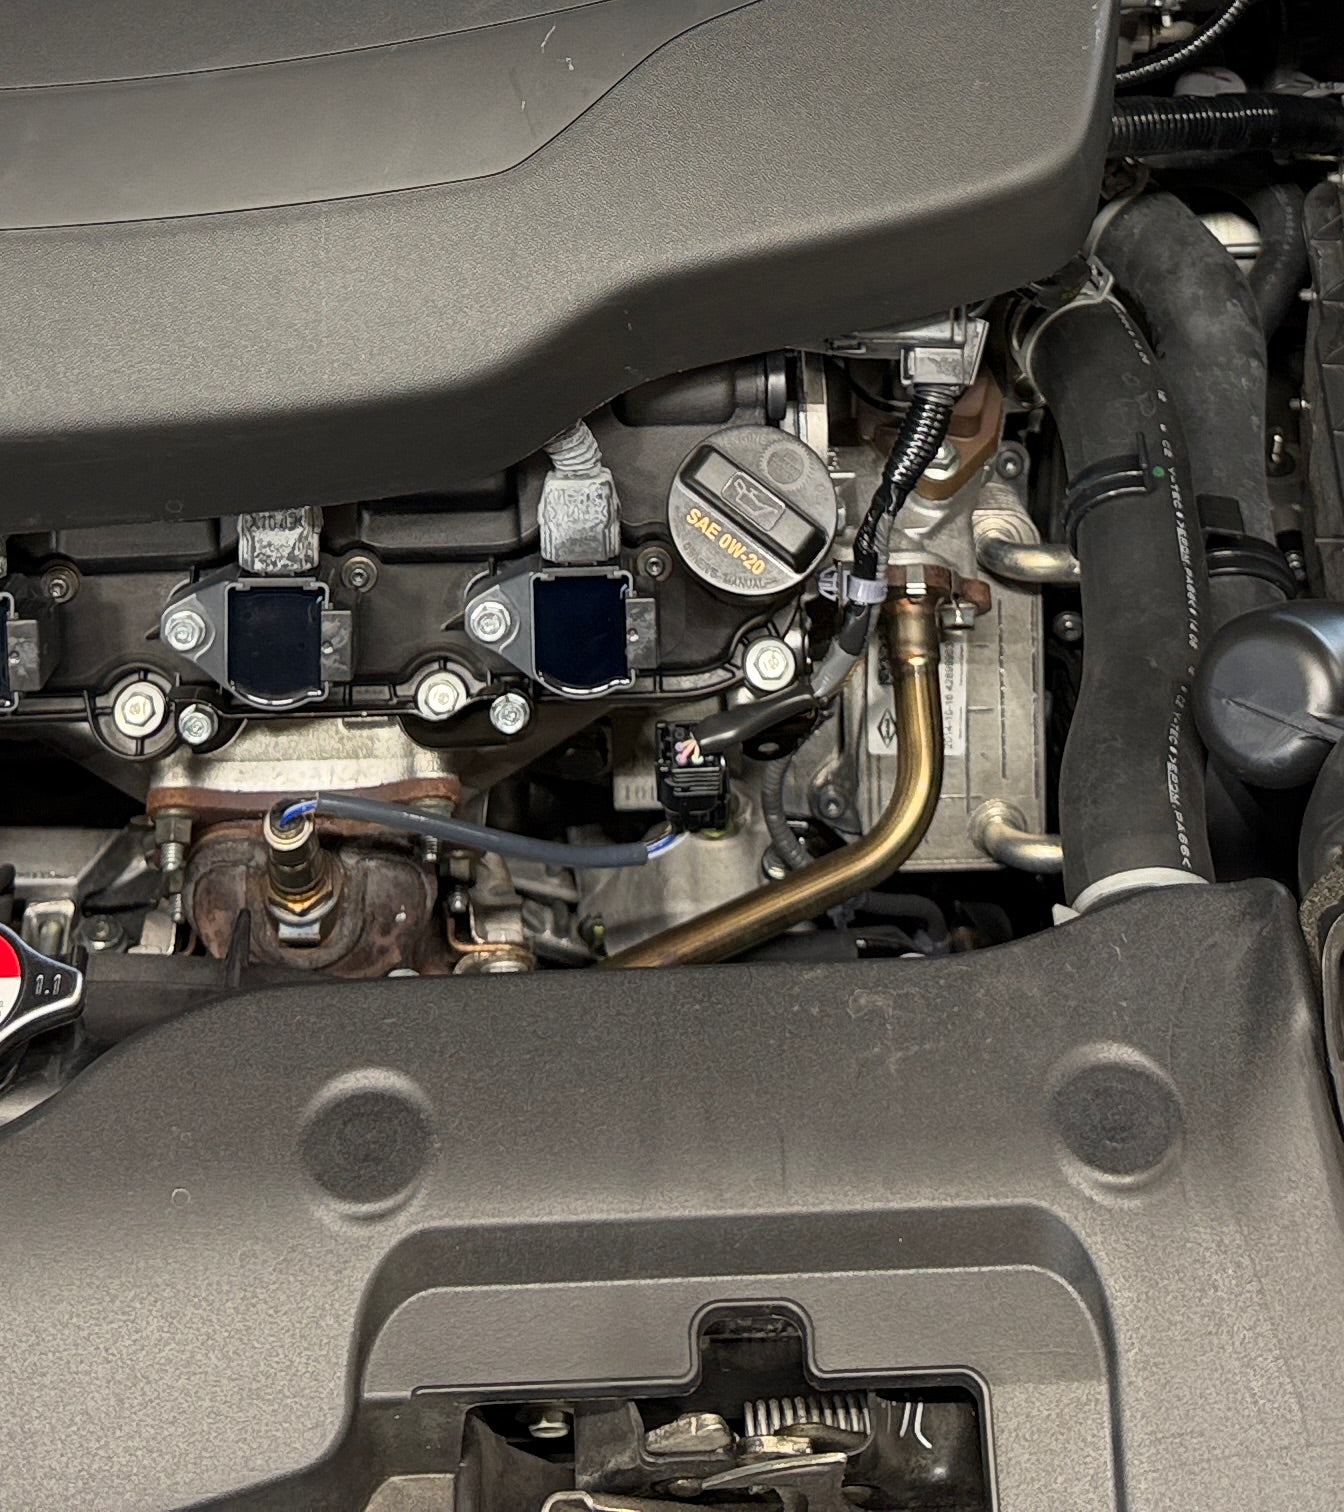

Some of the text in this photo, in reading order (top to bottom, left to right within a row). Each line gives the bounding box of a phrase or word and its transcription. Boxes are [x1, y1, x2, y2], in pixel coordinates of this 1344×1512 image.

[686, 508, 766, 576] SAE 0W-20
[36, 974, 62, 995] 1.1
